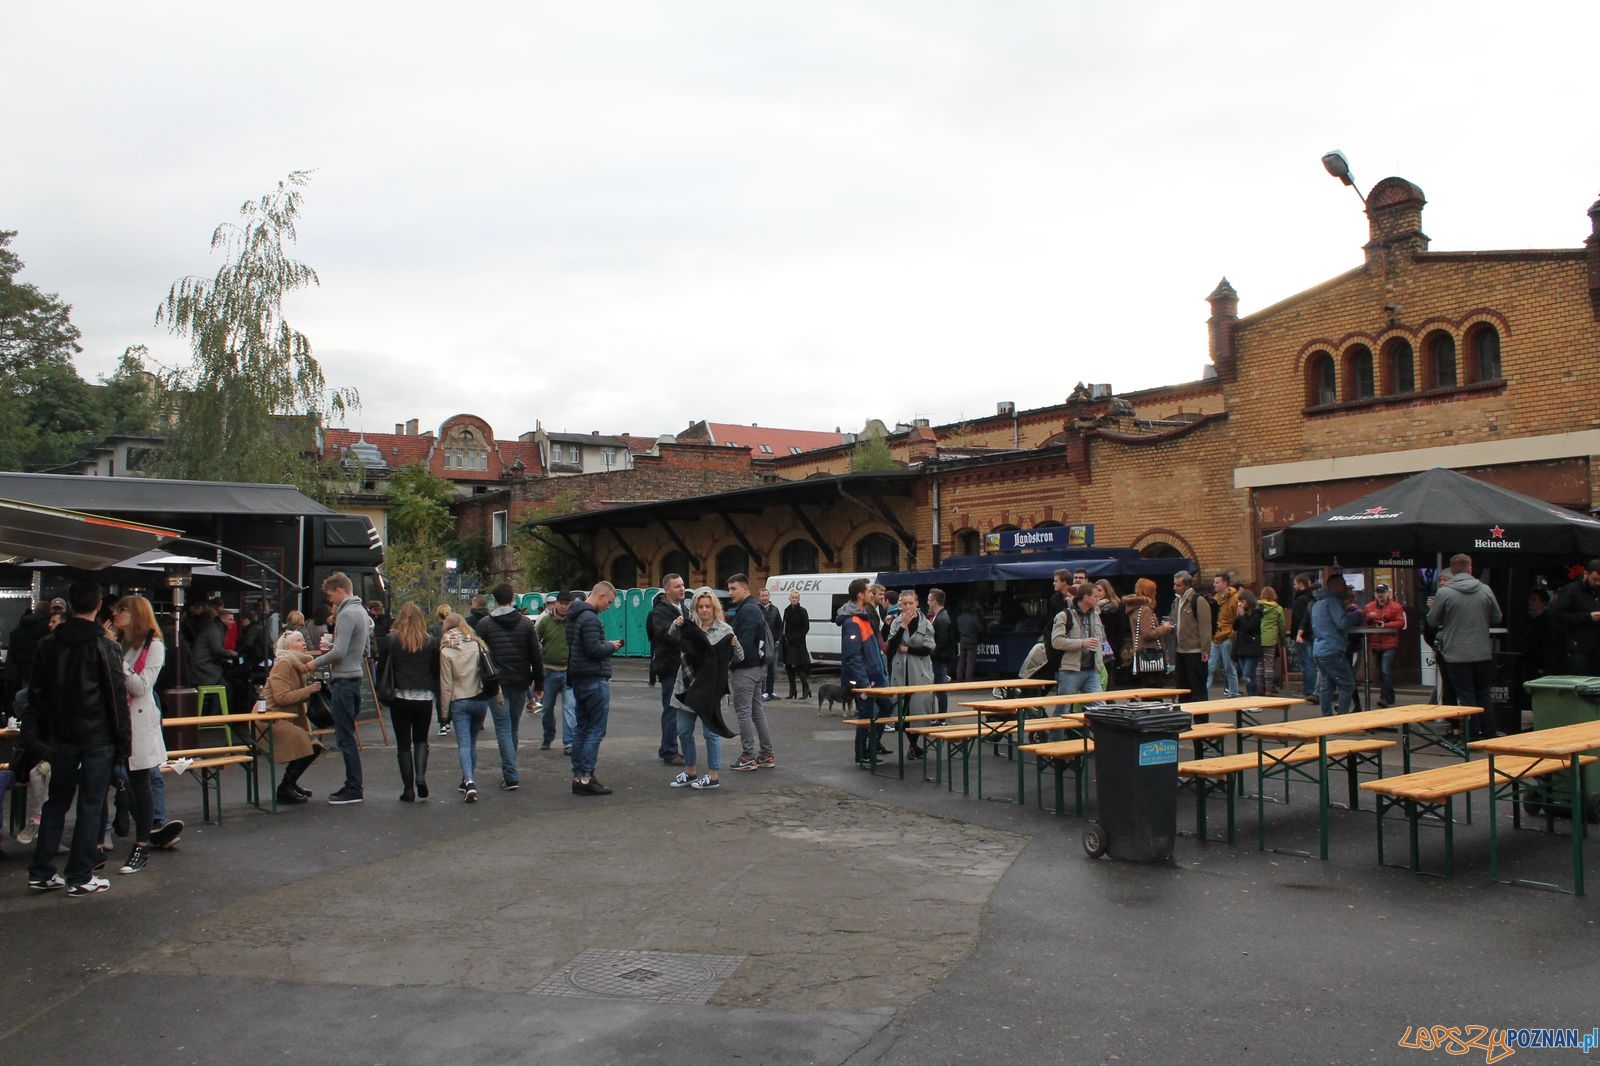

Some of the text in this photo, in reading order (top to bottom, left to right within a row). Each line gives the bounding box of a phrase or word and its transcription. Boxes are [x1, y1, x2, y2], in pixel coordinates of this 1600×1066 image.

[1013, 532, 1053, 547] Landskron
[1474, 539, 1520, 549] Heineken
[780, 580, 823, 592] JACEK
